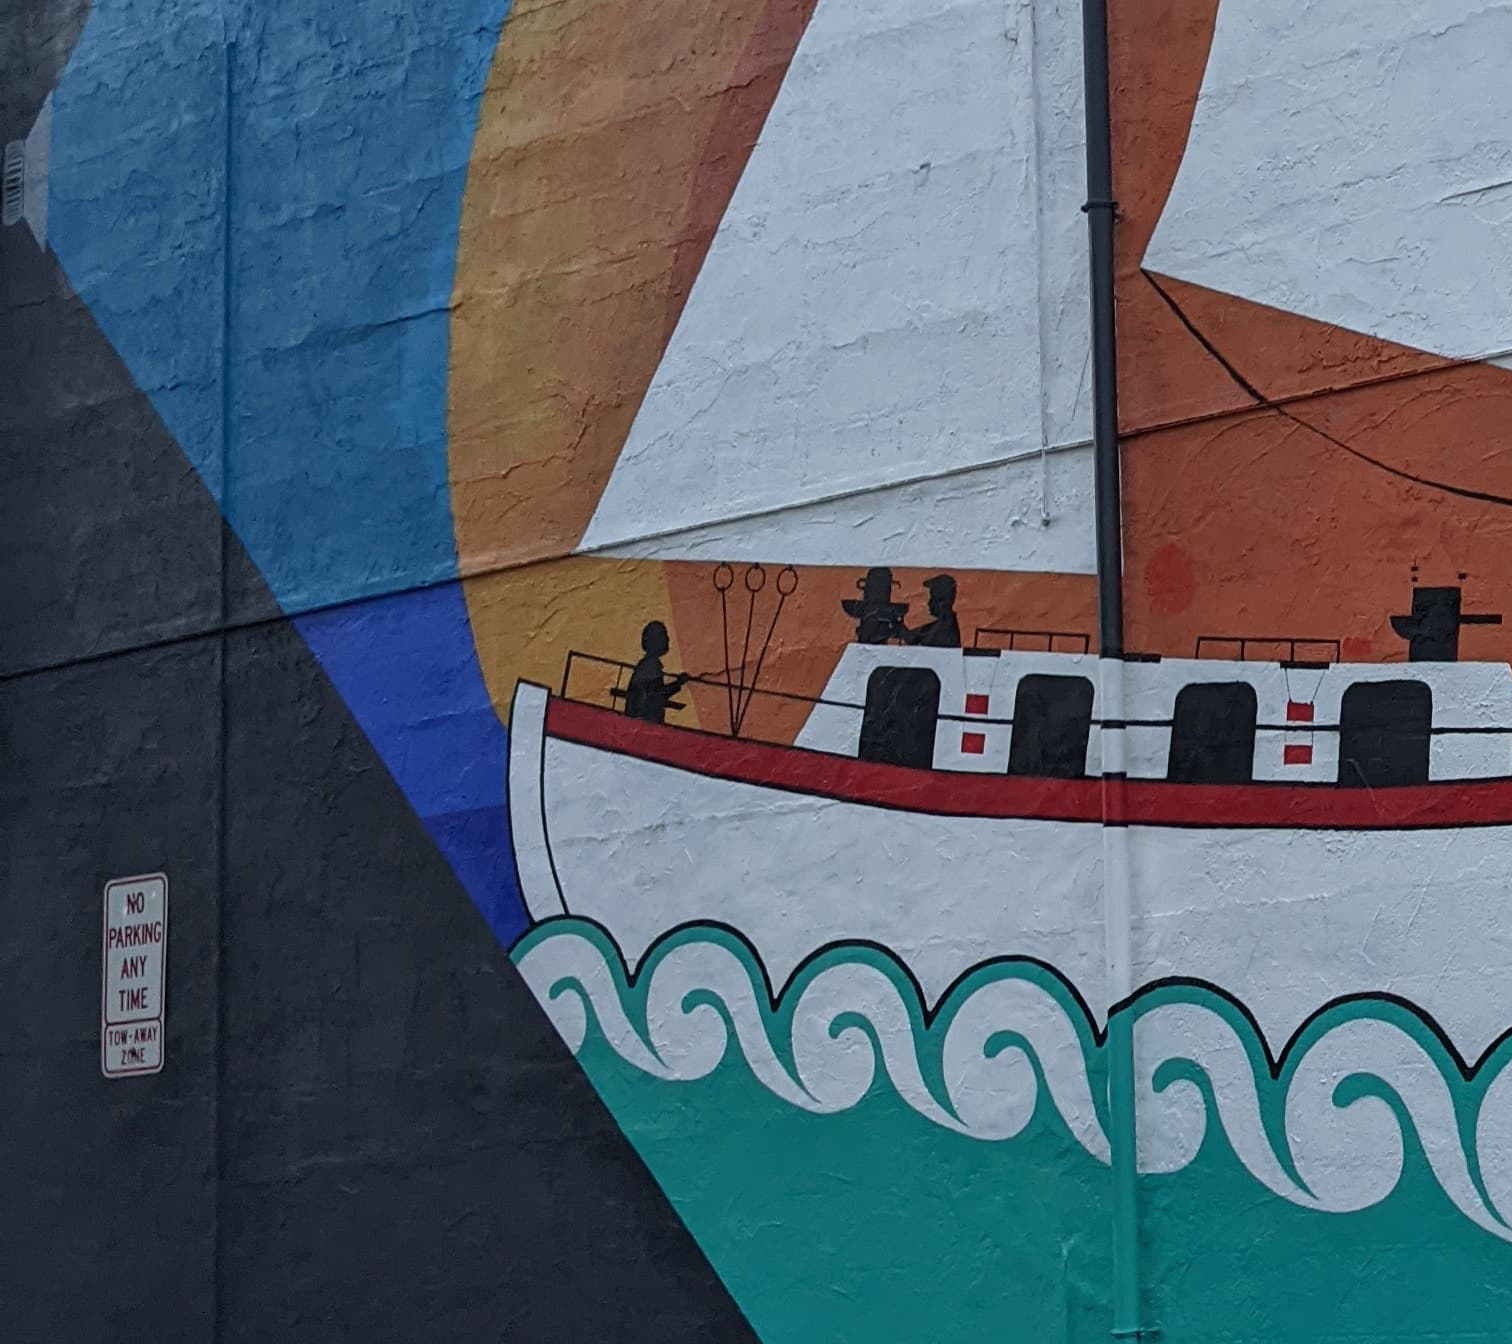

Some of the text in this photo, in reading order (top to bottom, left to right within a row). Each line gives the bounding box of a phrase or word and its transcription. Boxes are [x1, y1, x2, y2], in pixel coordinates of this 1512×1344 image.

[126, 892, 145, 915] NO
[108, 921, 162, 949] PARKING
[120, 955, 148, 980] ANY
[118, 987, 149, 1011] TIME
[108, 1025, 158, 1047] TOW-AWAY
[120, 1048, 146, 1066] ZONE
